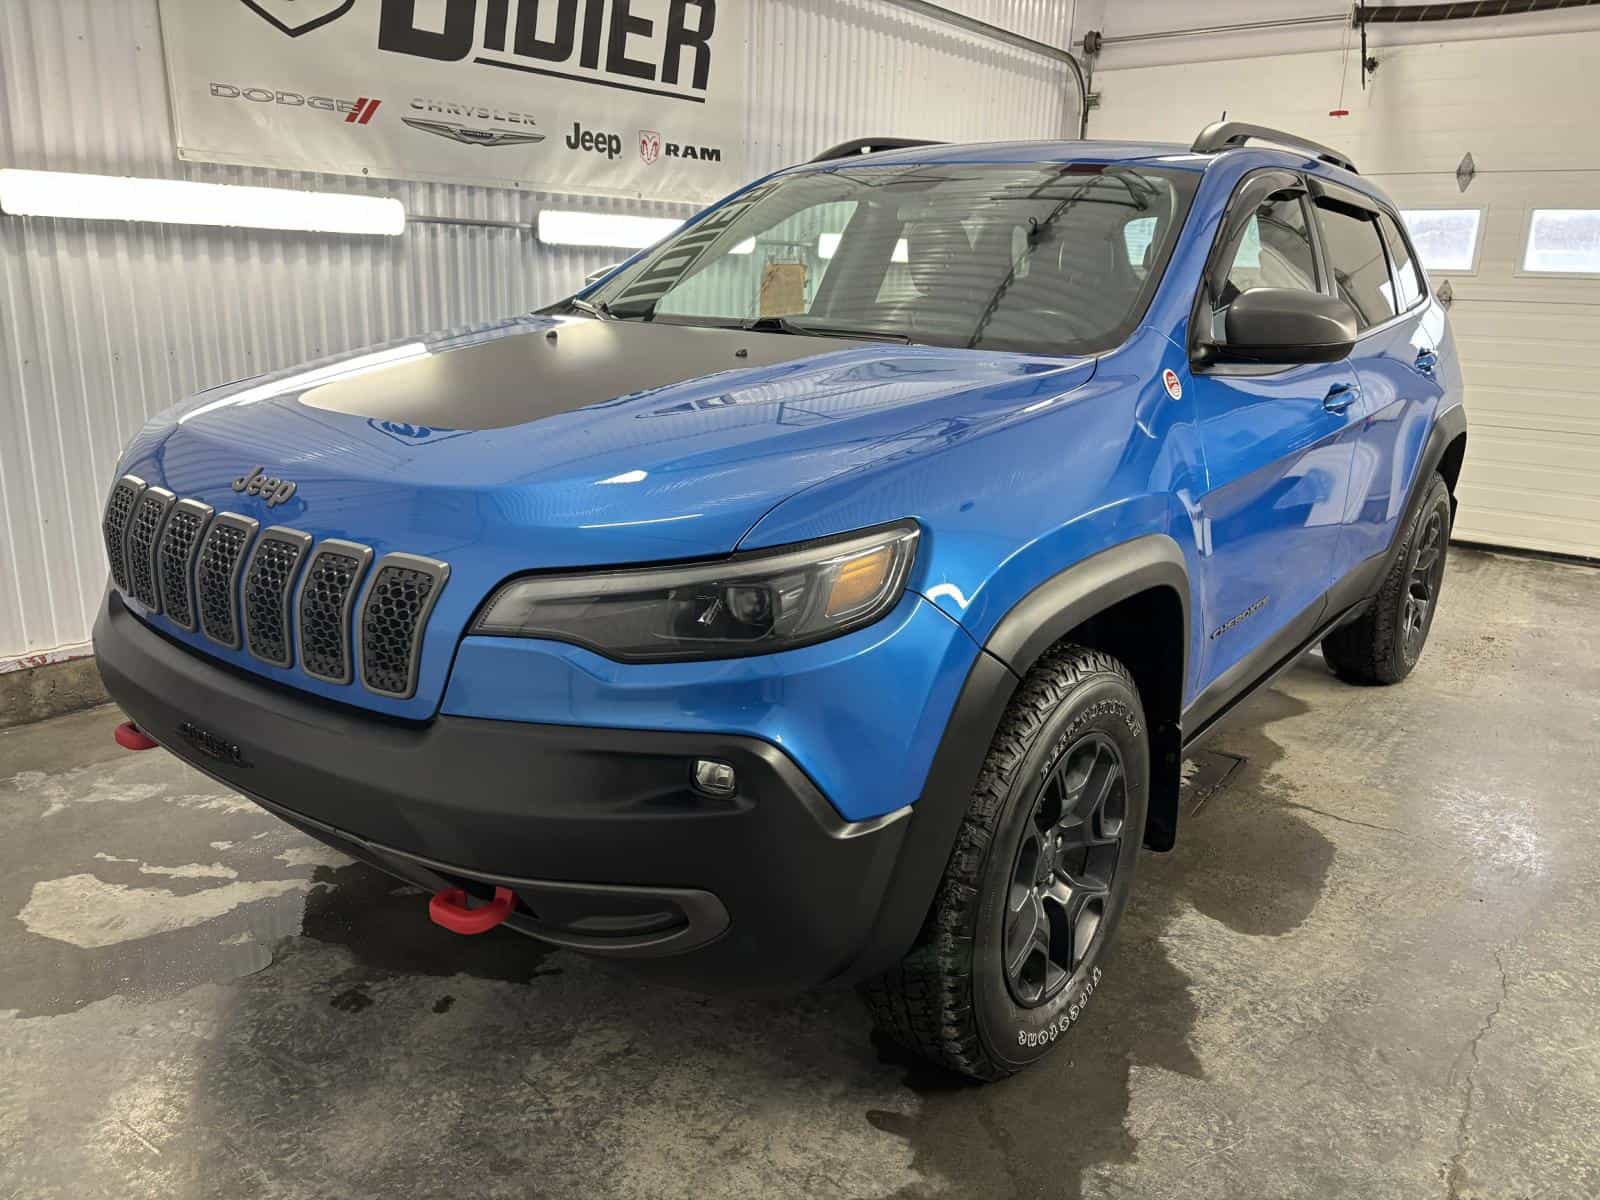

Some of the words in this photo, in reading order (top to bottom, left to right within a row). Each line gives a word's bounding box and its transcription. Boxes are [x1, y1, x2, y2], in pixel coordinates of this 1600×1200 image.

[208, 82, 360, 114] DODGE
[409, 97, 537, 127] CHRYSLER
[565, 121, 622, 161] Jeep
[664, 142, 722, 163] RAM
[231, 465, 298, 509] Jeep
